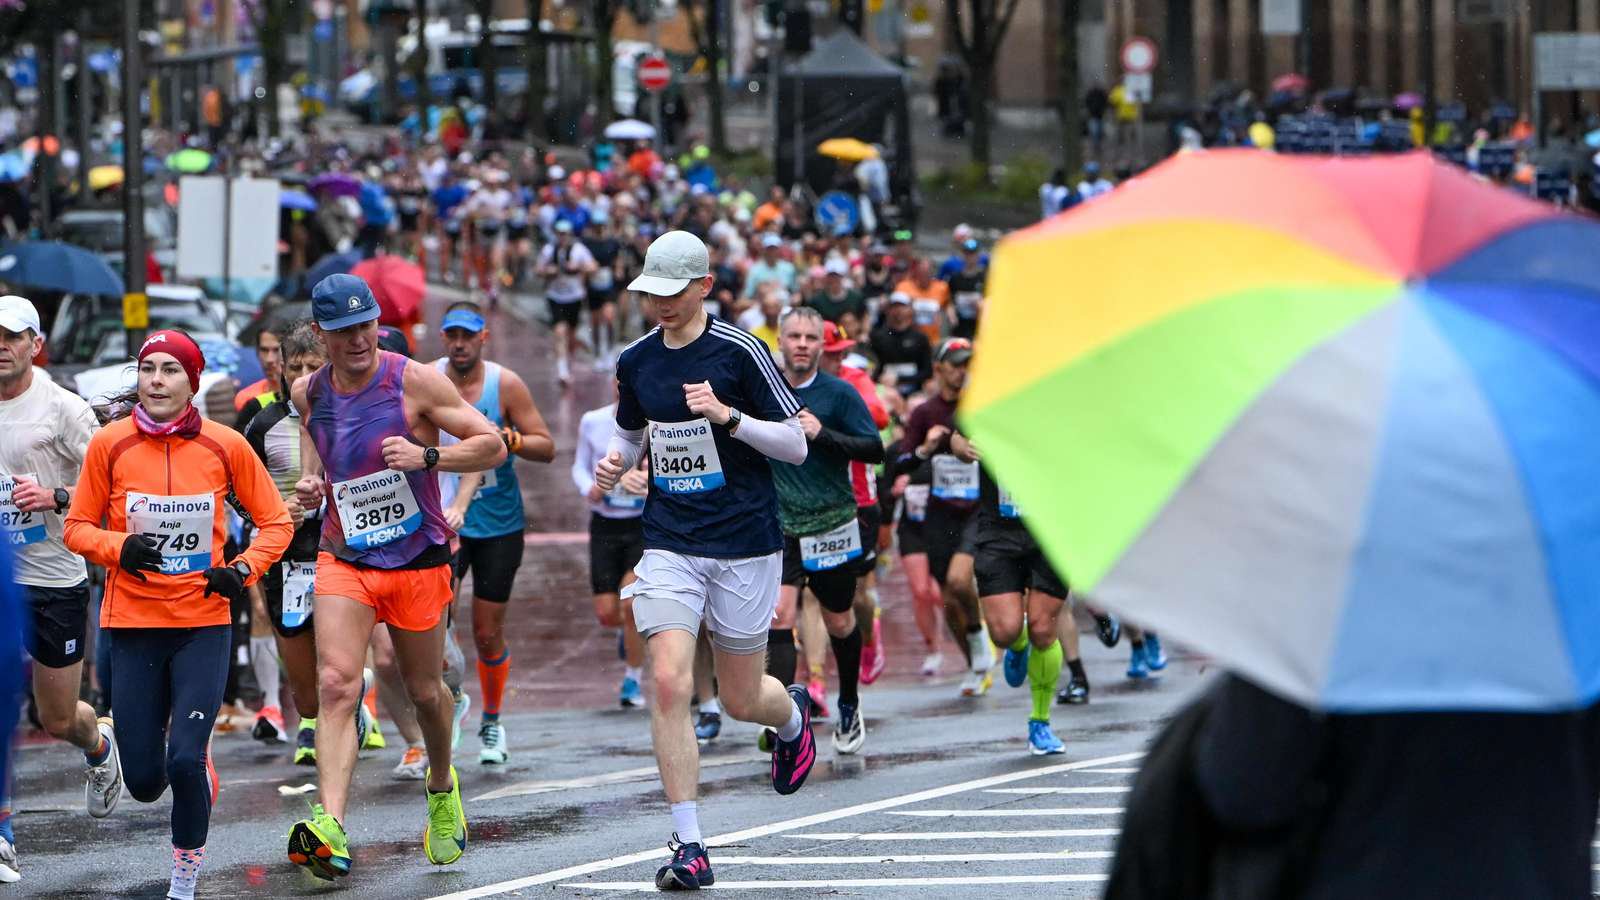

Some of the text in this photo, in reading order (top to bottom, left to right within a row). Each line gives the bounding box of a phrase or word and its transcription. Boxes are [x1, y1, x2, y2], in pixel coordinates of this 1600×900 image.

[660, 425, 707, 439] mainova
[665, 445, 688, 453] Niklas
[661, 455, 706, 474] 3404
[350, 473, 401, 495] mainova
[668, 477, 704, 491] HOKA
[149, 501, 210, 513] mainova
[353, 491, 396, 509] Karl-Rudolf
[355, 502, 405, 530] 3879
[160, 521, 181, 530] Anja
[366, 525, 407, 546] HOKA
[811, 537, 852, 554] 12821
[160, 557, 190, 571] OKA
